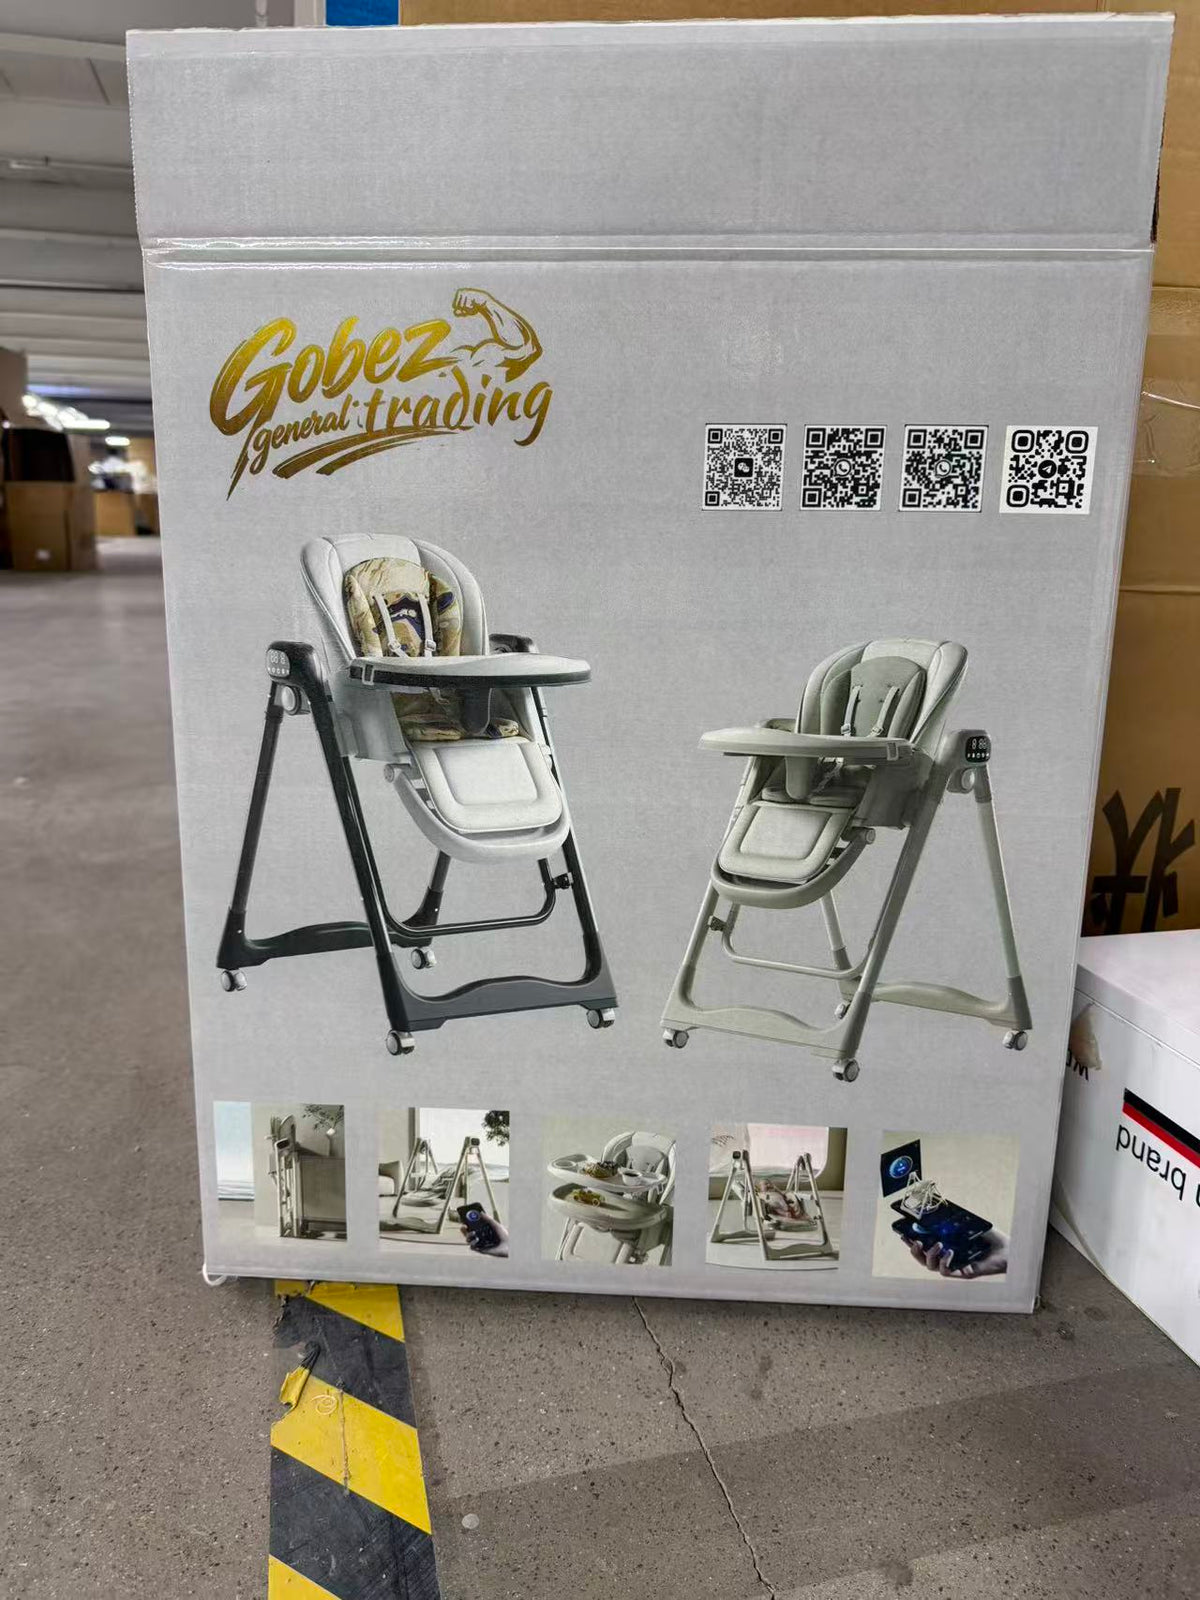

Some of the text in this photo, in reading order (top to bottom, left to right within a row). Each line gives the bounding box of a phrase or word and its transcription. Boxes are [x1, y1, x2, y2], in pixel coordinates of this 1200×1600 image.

[209, 315, 462, 501] Gobez
[250, 366, 554, 476] general trading
[1115, 1124, 1187, 1201] brand
